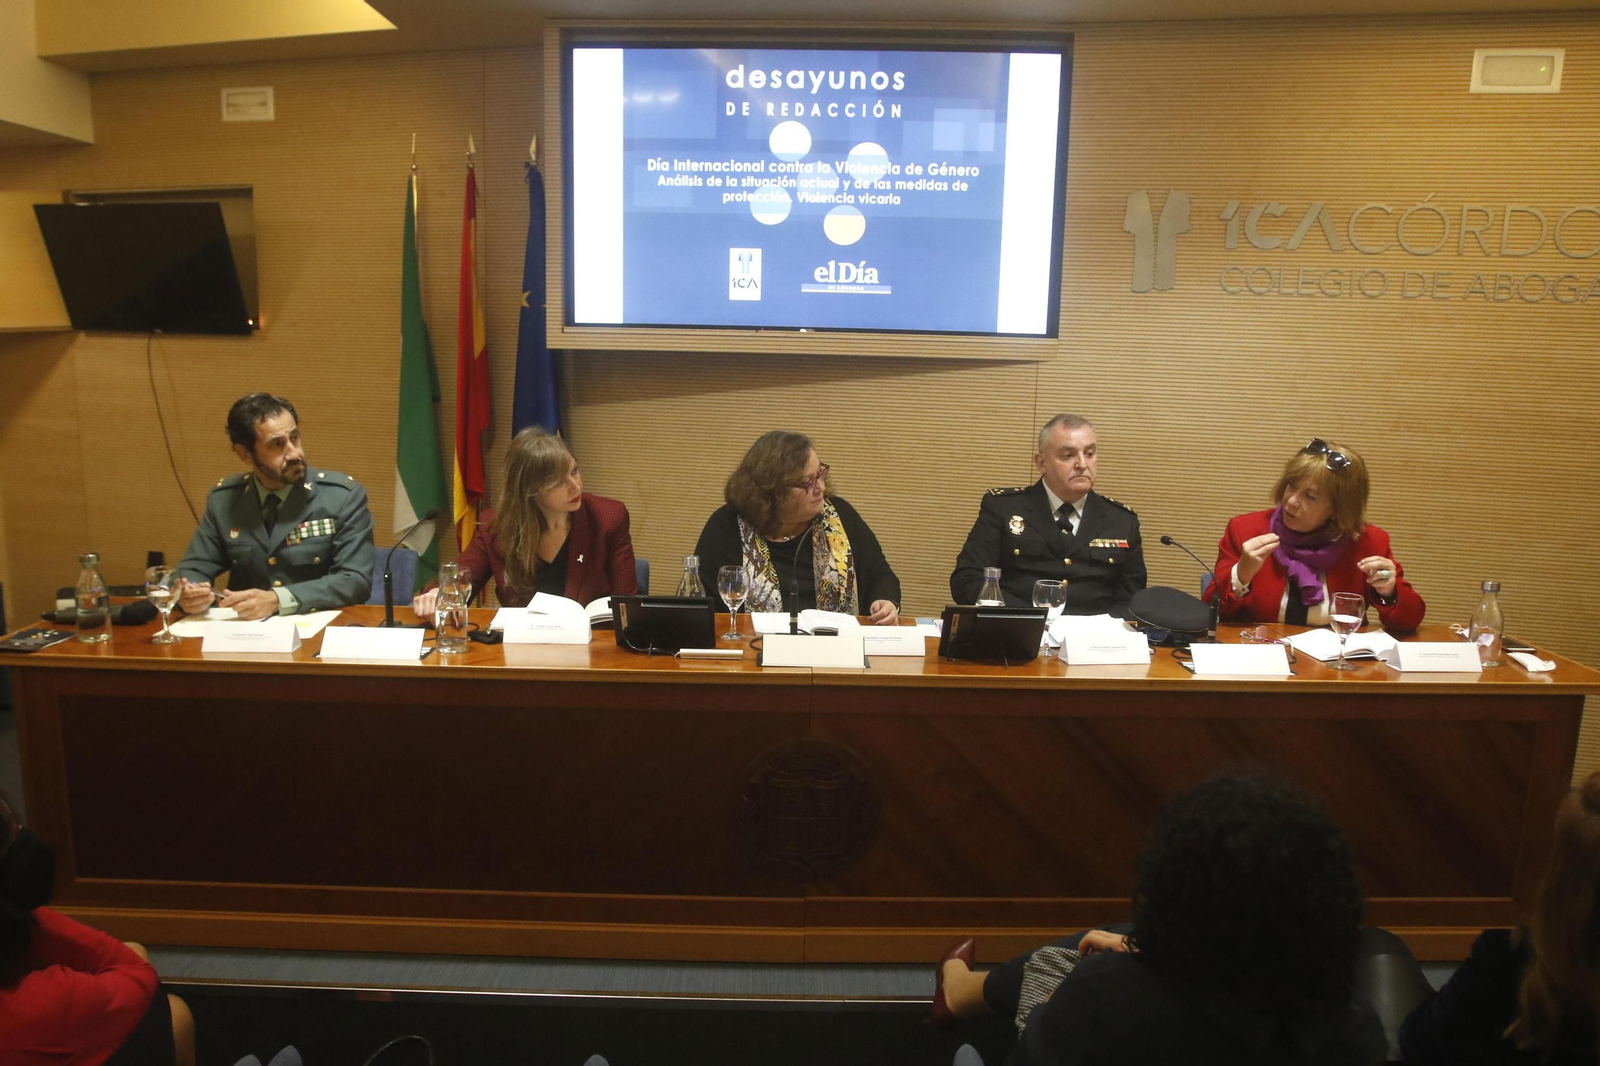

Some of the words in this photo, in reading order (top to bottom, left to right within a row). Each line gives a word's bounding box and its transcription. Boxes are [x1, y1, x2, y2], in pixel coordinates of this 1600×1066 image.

[725, 64, 906, 94] desayunos
[726, 102, 751, 117] DE
[766, 99, 902, 119] REDACCIÓN
[647, 157, 670, 172] Día
[673, 158, 765, 173] Internacional
[768, 160, 814, 174] contra
[817, 160, 831, 174] la
[835, 161, 901, 175] Violencia
[905, 162, 924, 176] de
[927, 161, 980, 177] Género
[657, 174, 704, 187] Análisis
[706, 175, 723, 187] de
[725, 175, 738, 187] la
[741, 175, 797, 188] situación
[800, 176, 840, 189] actual
[843, 179, 851, 191] y
[854, 178, 871, 190] de
[873, 178, 892, 190] las
[895, 179, 949, 191] medidas
[952, 180, 969, 192] de
[796, 191, 855, 205] Violencia
[858, 192, 902, 205] vicaria
[1219, 267, 1390, 299] COLEGIO
[1402, 270, 1454, 300] DE
